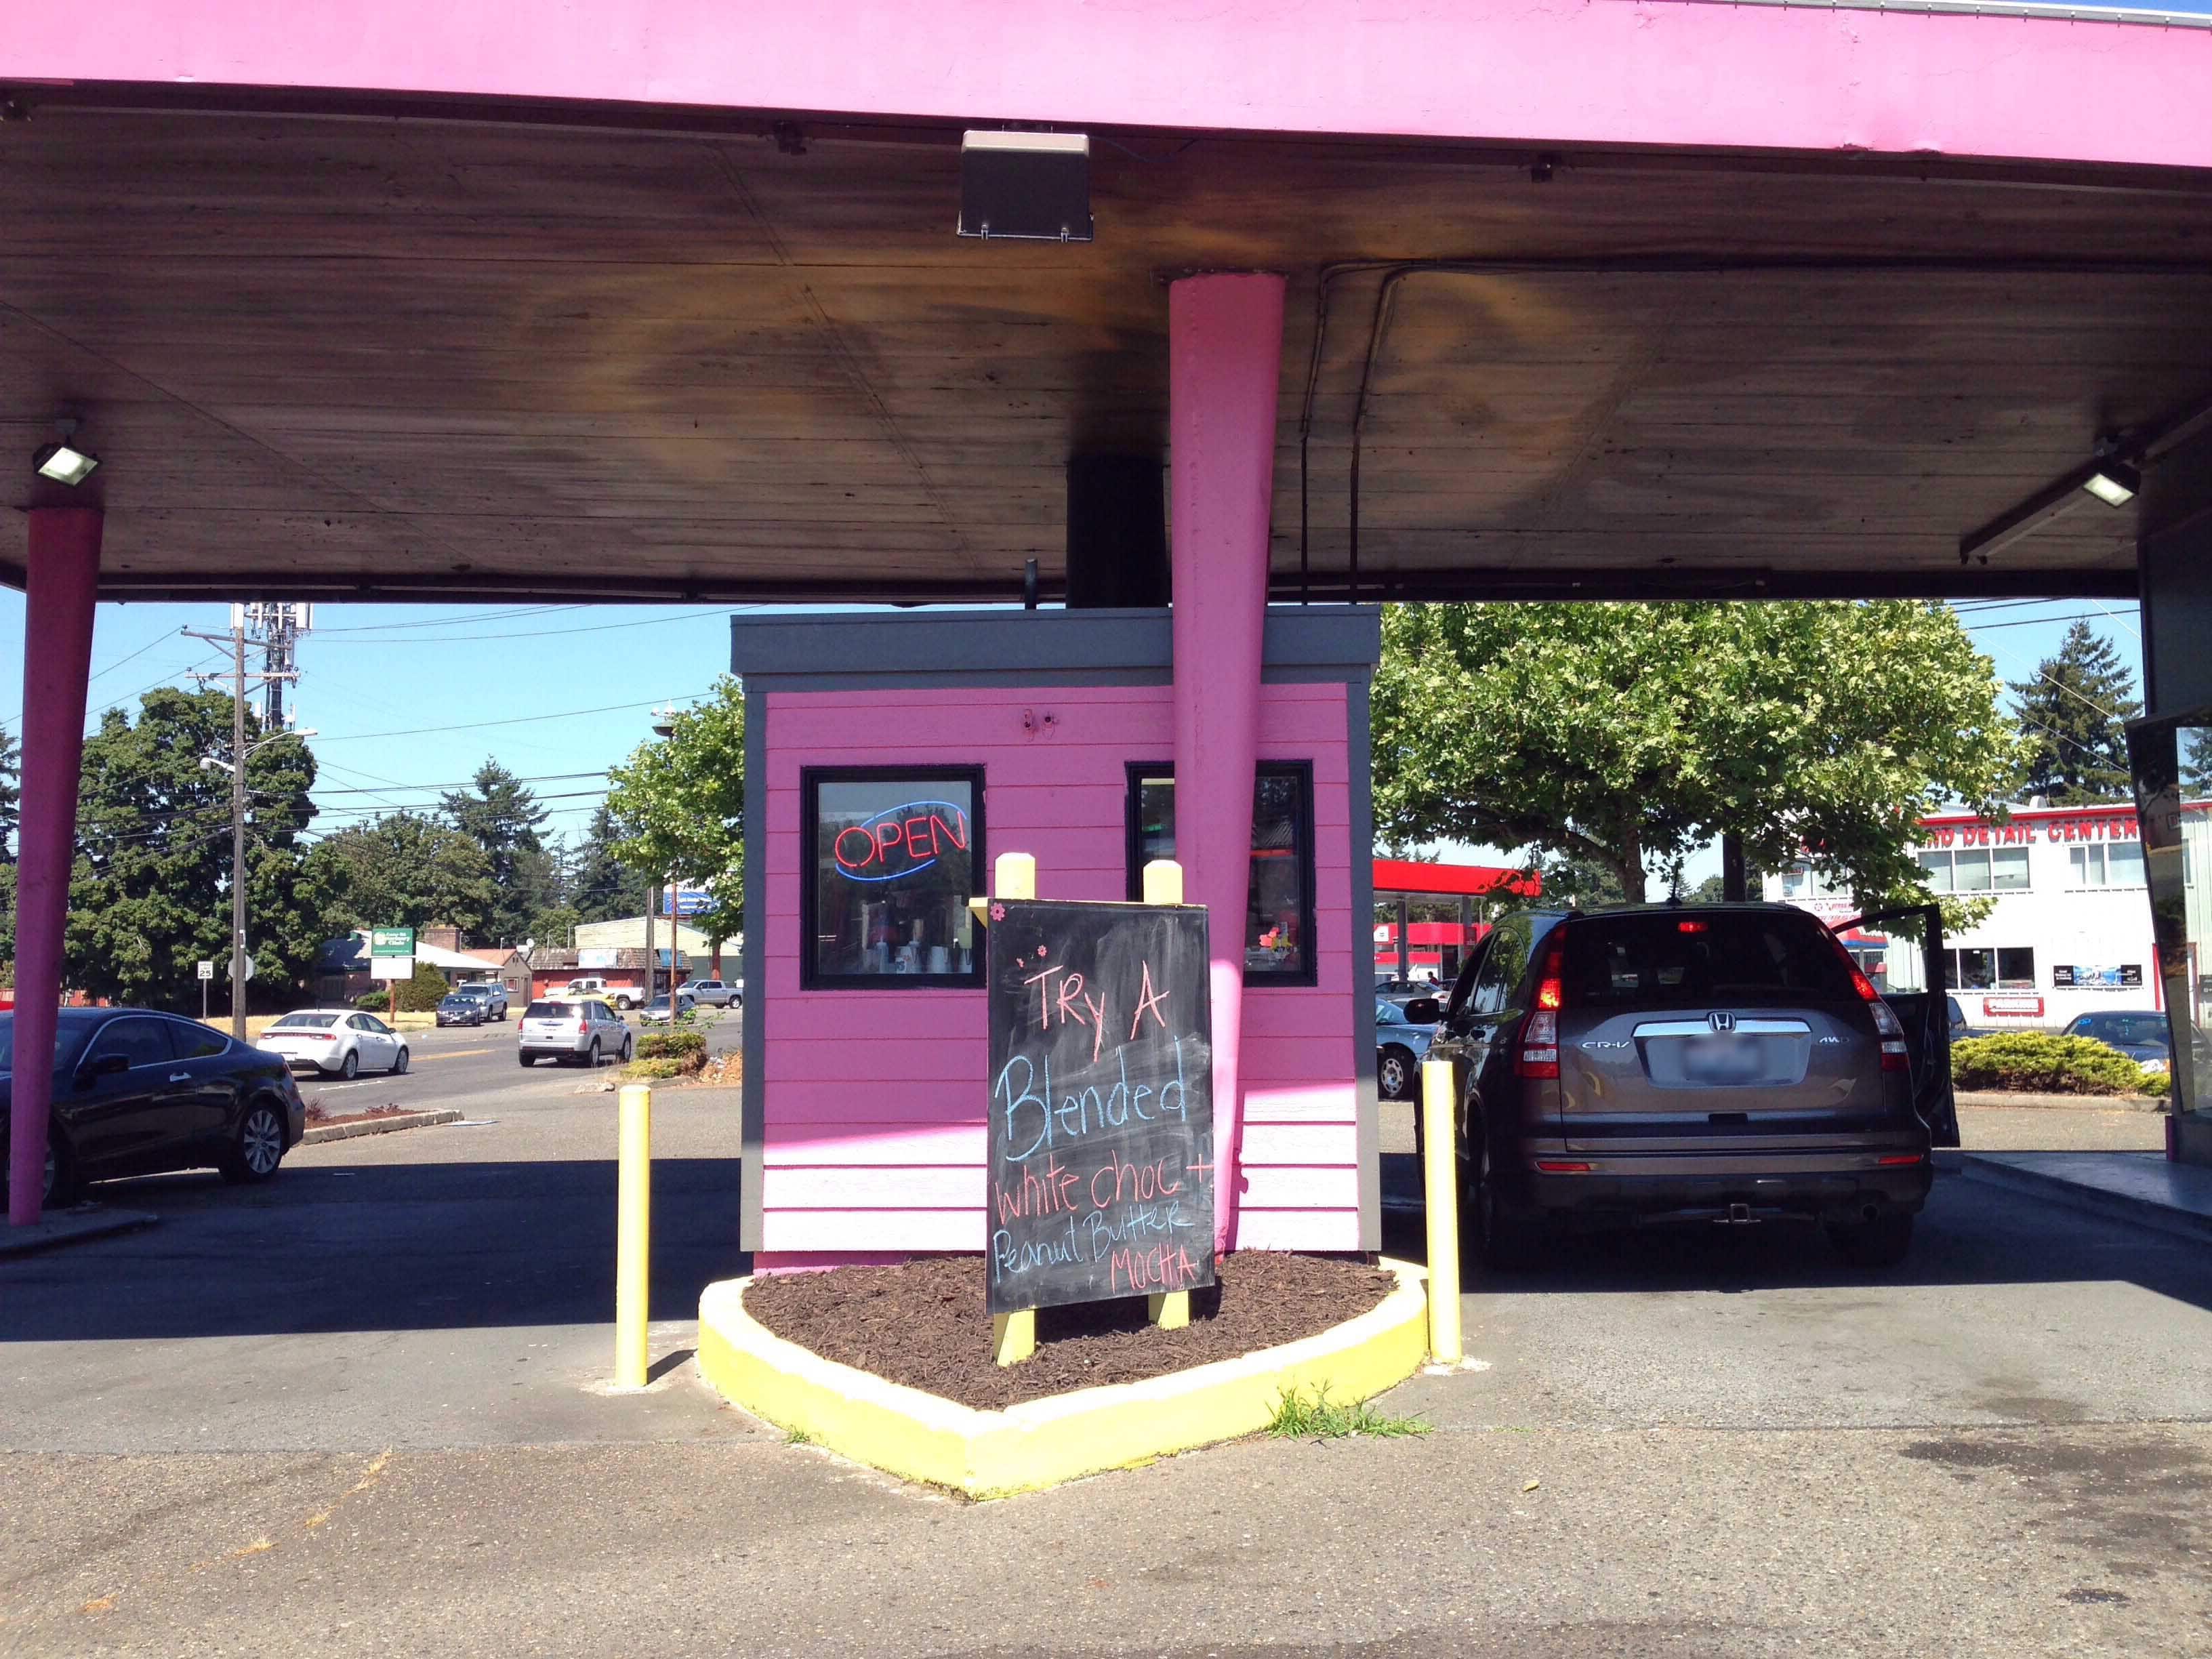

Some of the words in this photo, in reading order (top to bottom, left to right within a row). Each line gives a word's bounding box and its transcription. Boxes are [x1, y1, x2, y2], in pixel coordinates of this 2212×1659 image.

[835, 811, 966, 868] OPEN
[1963, 823, 2036, 846] DETAIL
[2047, 818, 2139, 843] CENTER
[1130, 960, 1170, 1040] A
[994, 1035, 1187, 1161] Blended
[993, 1216, 1084, 1284] Peanut
[1111, 1242, 1200, 1294] MOCHA
